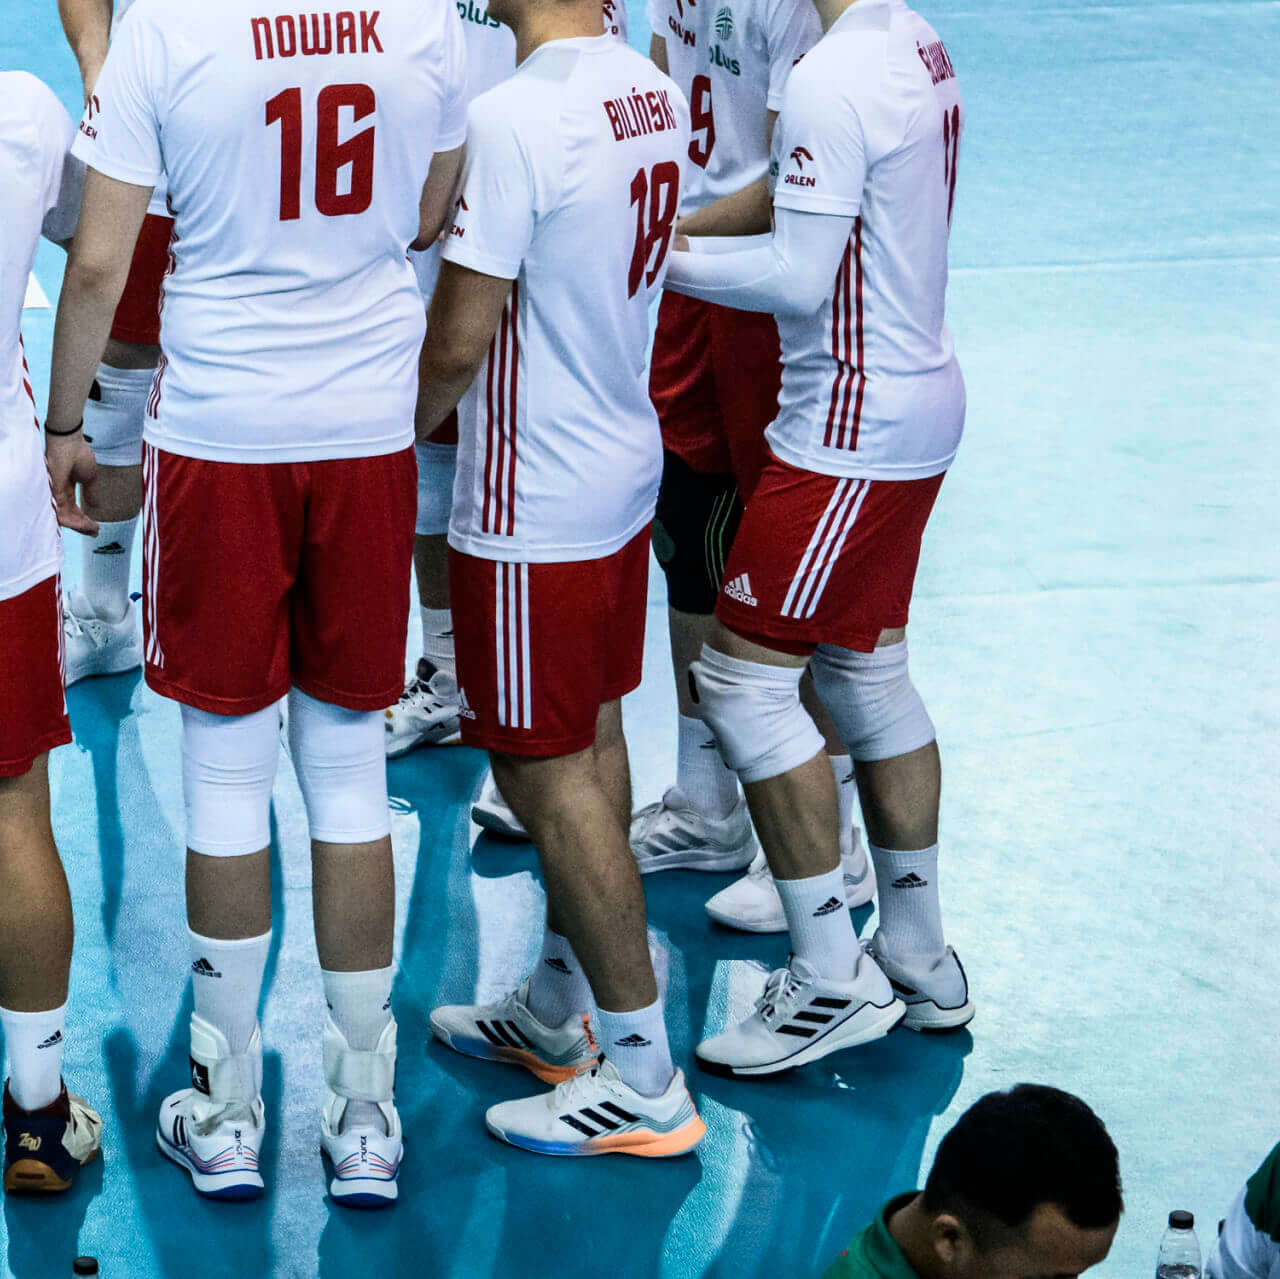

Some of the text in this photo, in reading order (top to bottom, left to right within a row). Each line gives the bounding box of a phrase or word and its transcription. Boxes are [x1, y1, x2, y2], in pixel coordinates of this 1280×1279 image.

[250, 10, 384, 61] NOWAK
[264, 82, 376, 221] 16
[687, 74, 715, 170] 9
[783, 174, 817, 188] ORLEN
[627, 159, 680, 300] 18
[724, 584, 758, 607] adidas
